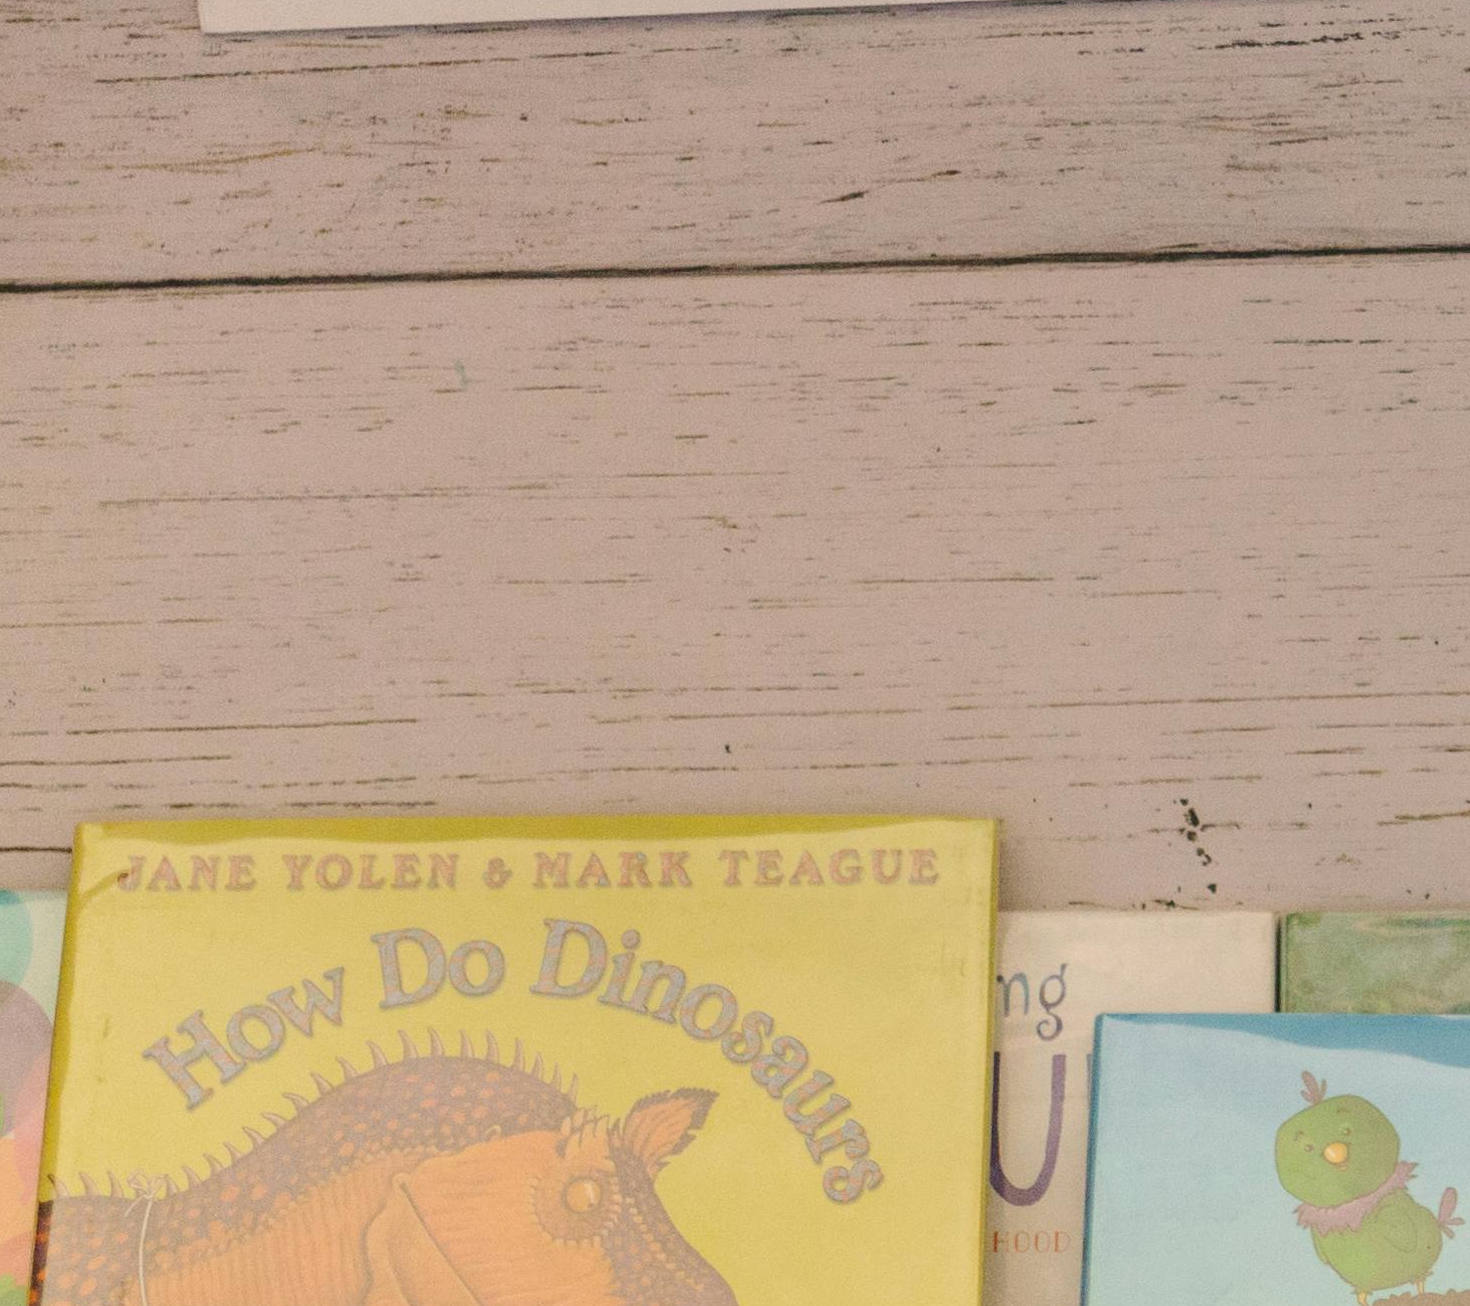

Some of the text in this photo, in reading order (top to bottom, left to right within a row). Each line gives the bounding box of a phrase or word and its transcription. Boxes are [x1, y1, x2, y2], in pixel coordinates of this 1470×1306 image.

[115, 846, 942, 894] JANE YOLEN & MARK TEAGUE
[141, 966, 350, 1111] How
[370, 924, 507, 1012] Do
[529, 916, 888, 1207] Dinosaurs
